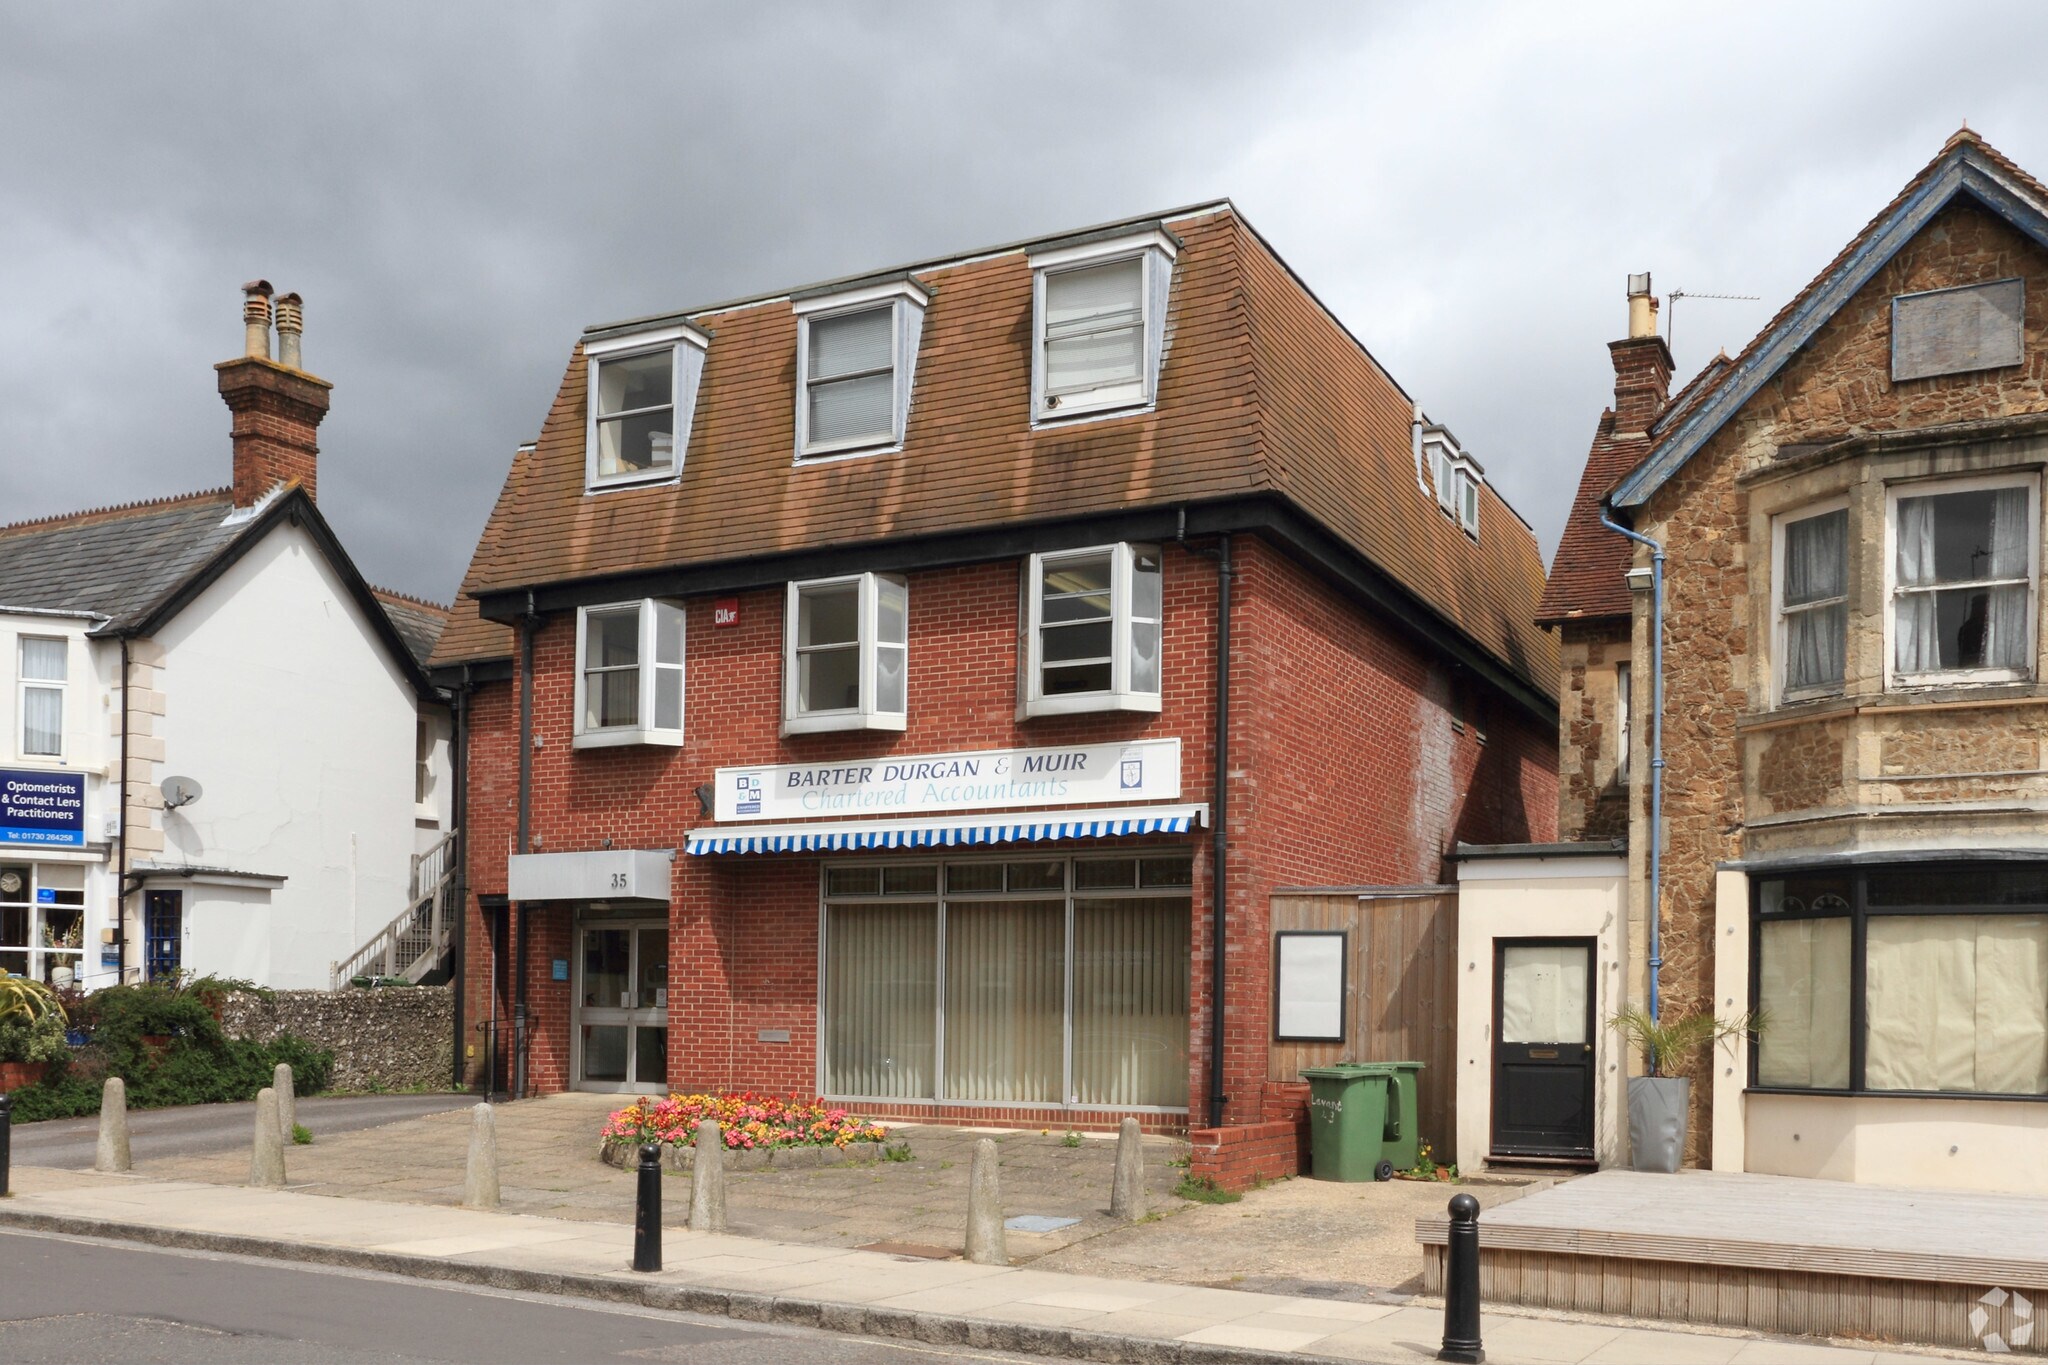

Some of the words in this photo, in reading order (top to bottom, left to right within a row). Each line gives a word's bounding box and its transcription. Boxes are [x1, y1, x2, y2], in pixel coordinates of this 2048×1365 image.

[715, 608, 729, 624] CIA
[787, 766, 873, 788] BARTER
[883, 759, 981, 783] DURGAN
[994, 756, 1009, 775] &
[1022, 751, 1088, 773] MUIR
[7, 781, 76, 794] Optometrists
[802, 783, 907, 811] Chartered
[922, 774, 1068, 807] Accountants
[1, 794, 10, 803] &
[12, 794, 54, 806] Contact
[57, 797, 81, 807] Lens
[7, 807, 74, 820] Practitioners
[7, 831, 20, 839] Tel:
[22, 832, 44, 840] 01730
[611, 873, 627, 889] 35
[1311, 1093, 1343, 1112] Lavant
